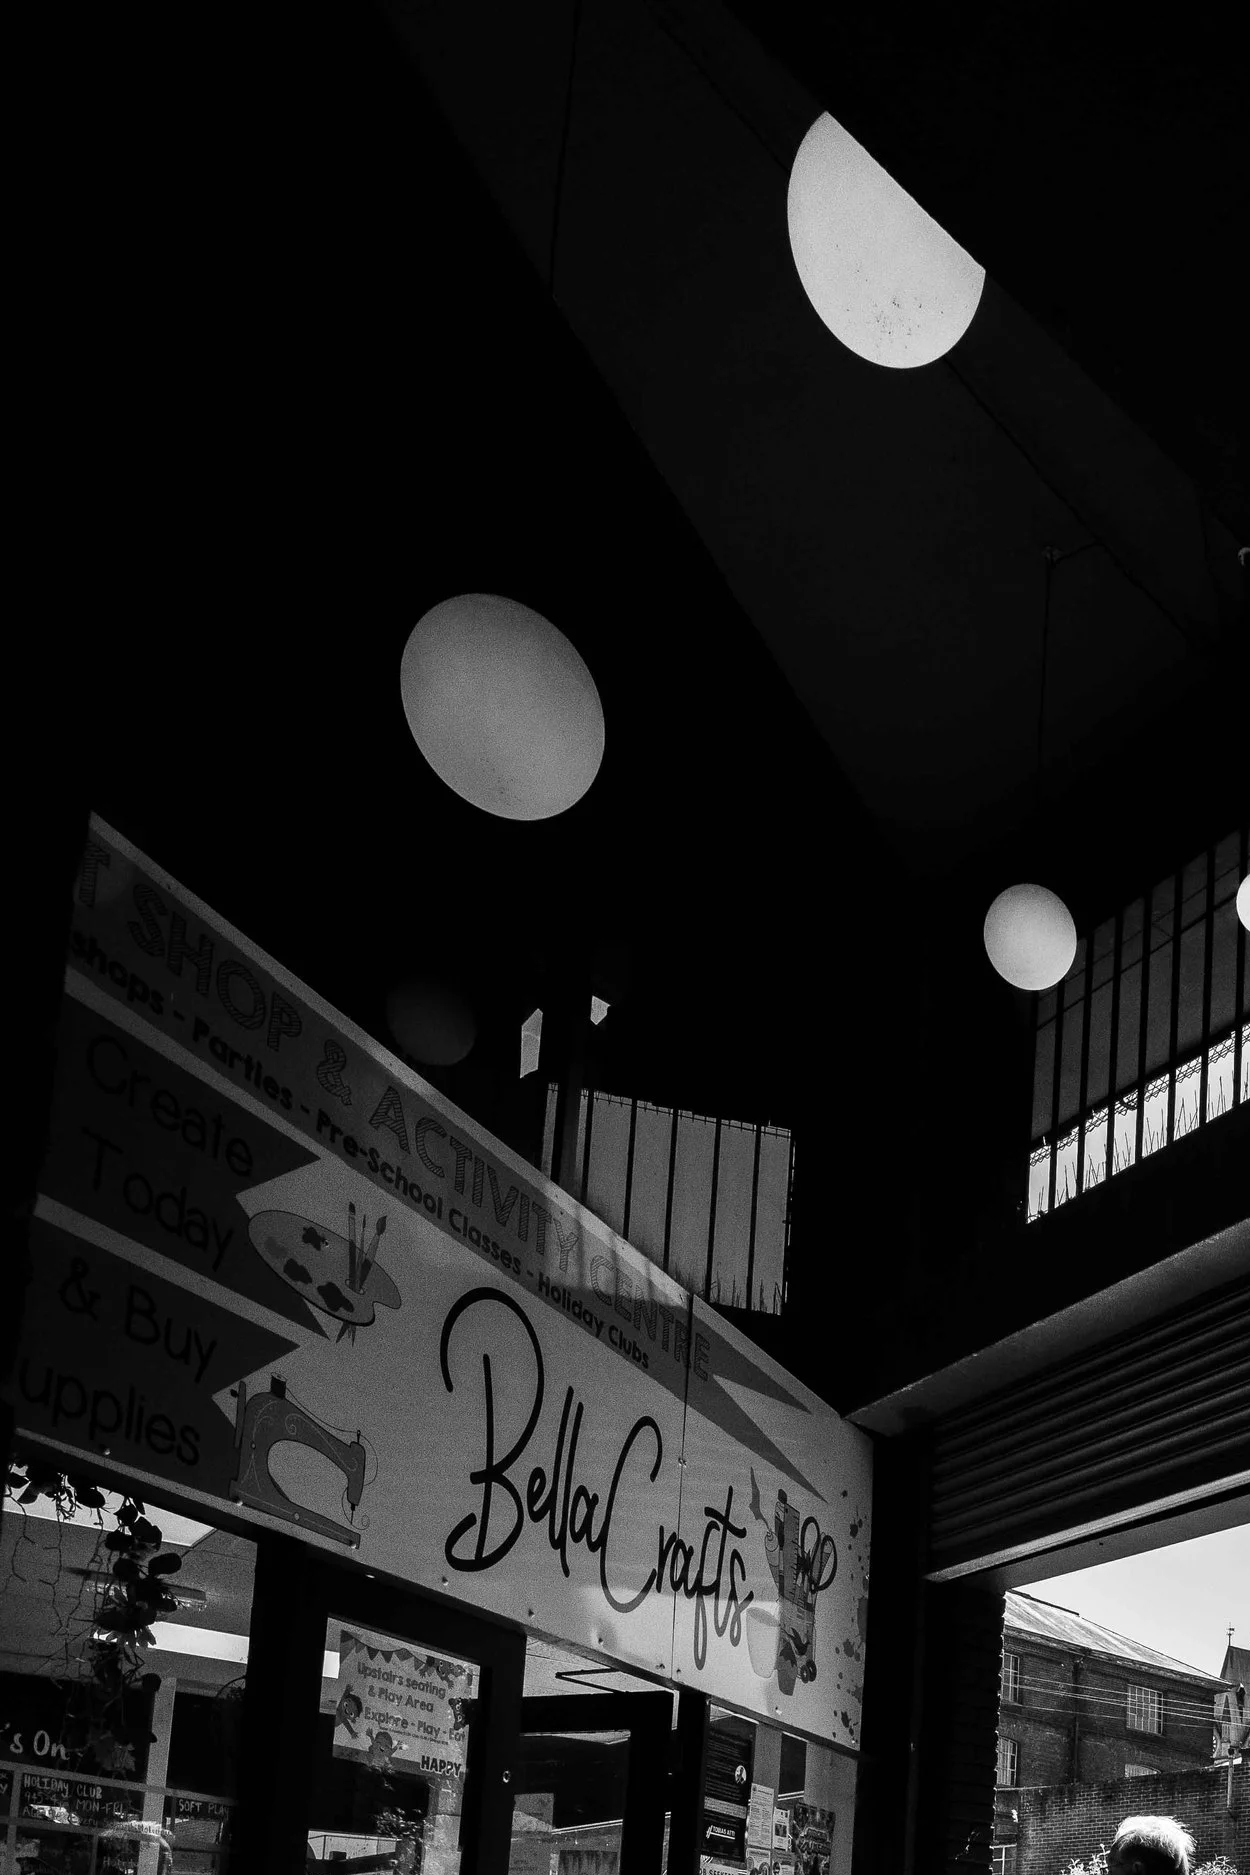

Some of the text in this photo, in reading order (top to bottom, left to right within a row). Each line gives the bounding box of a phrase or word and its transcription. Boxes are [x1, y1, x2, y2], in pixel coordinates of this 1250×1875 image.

[86, 1035, 253, 1177] Create
[127, 883, 302, 1051] SHOP
[316, 1039, 352, 1106] &
[369, 1086, 579, 1272] ACTIVITY
[590, 1255, 711, 1381] CENTRE
[81, 1126, 234, 1272] Today
[193, 1016, 293, 1110] Parties
[316, 1108, 443, 1220] Pre-School
[448, 1208, 522, 1276] Classes
[538, 1271, 604, 1338] Holiday
[608, 1325, 650, 1369] Clubs
[58, 1256, 217, 1384] & Buy
[357, 1661, 446, 1700] Upstairs seating
[364, 1706, 409, 1729] Explore
[417, 1719, 441, 1737] Play
[378, 1687, 403, 1707] Play
[404, 1694, 434, 1713] Area
[178, 1798, 203, 1813] SOFT
[420, 1755, 462, 1777] HAPPY
